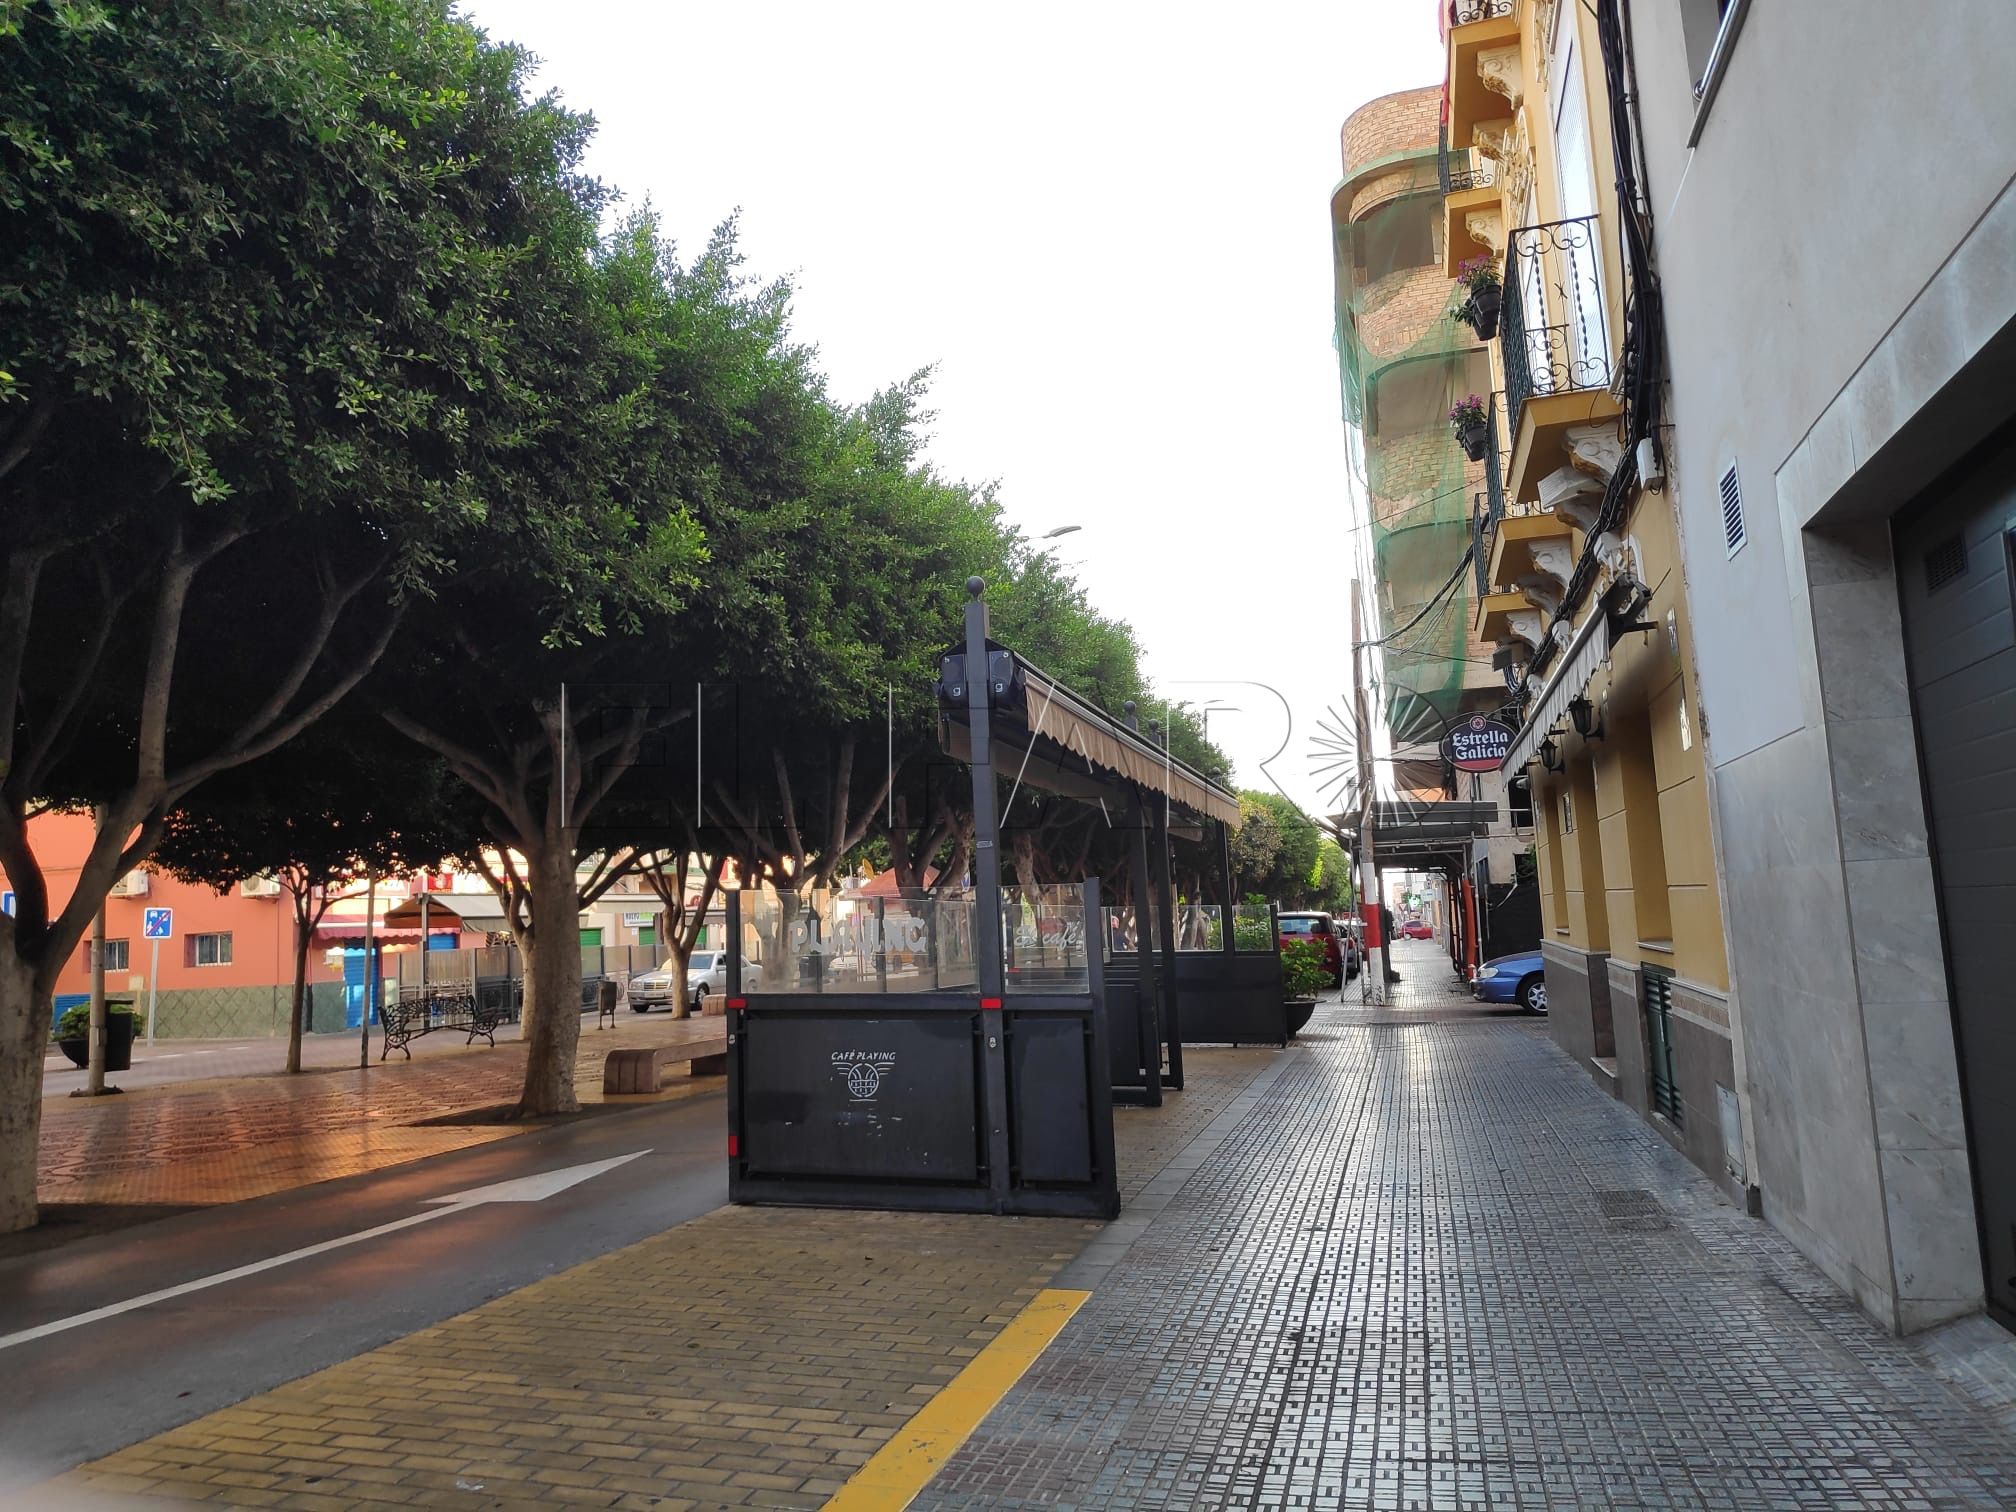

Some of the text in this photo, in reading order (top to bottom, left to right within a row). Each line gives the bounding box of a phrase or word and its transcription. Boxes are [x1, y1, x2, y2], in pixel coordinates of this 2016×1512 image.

[1452, 730, 1509, 747] Estrella
[1455, 744, 1506, 760] Galicia
[831, 1049, 896, 1061] CAFÉ PLAYING
